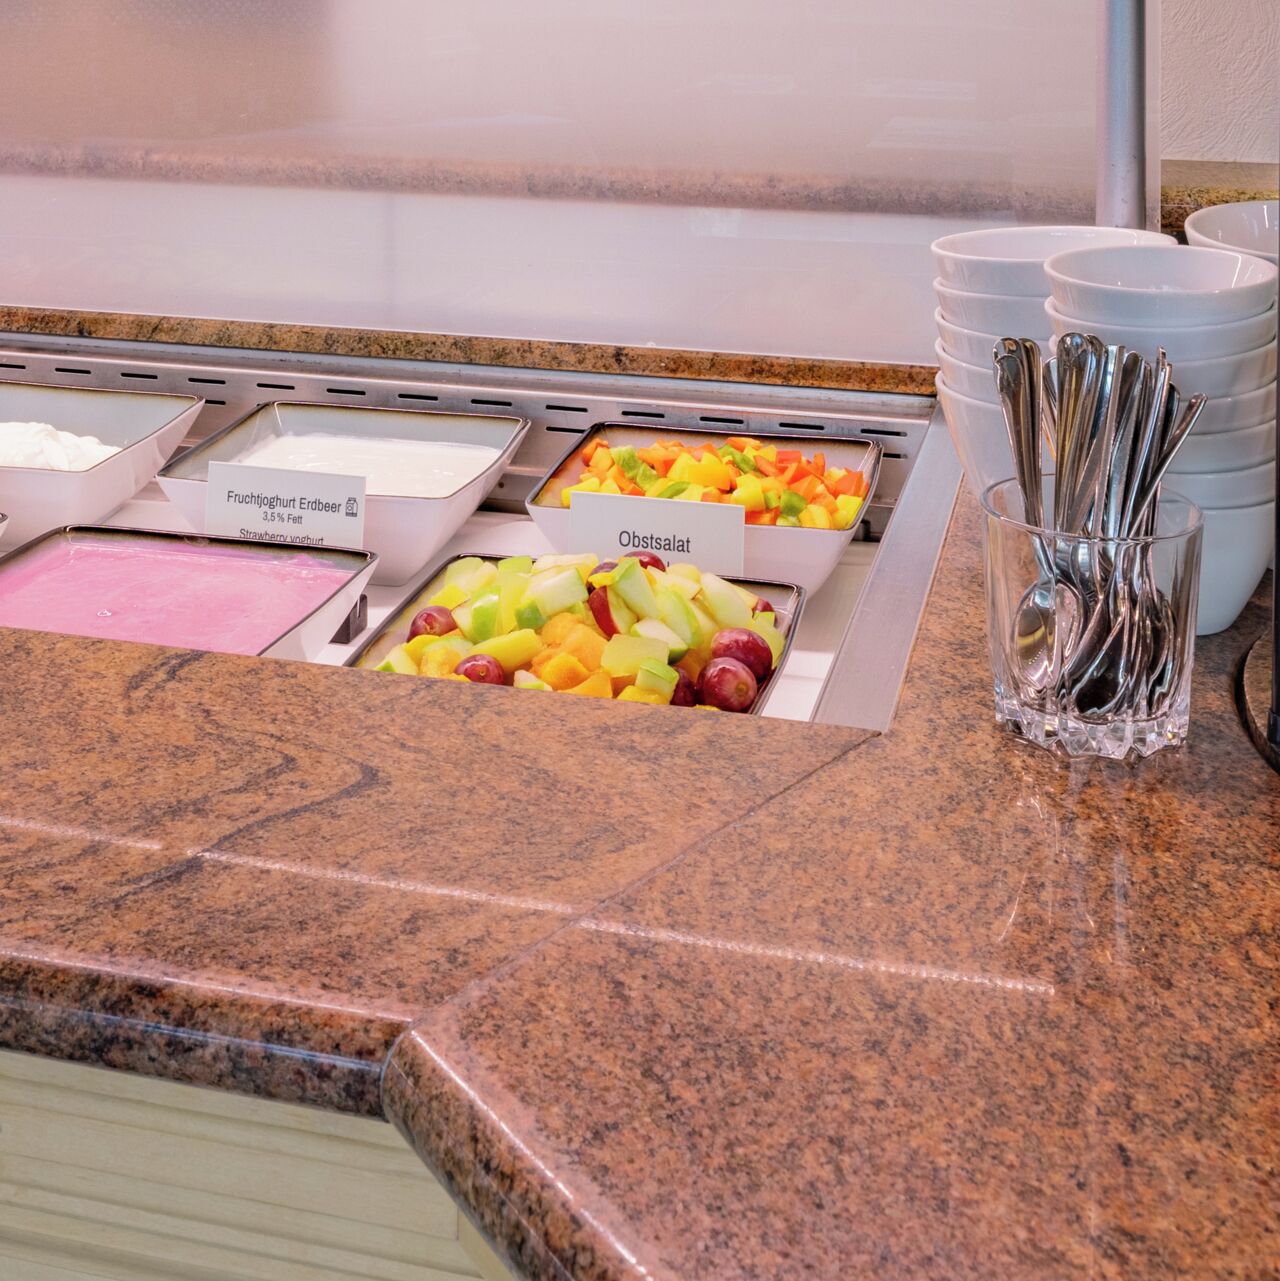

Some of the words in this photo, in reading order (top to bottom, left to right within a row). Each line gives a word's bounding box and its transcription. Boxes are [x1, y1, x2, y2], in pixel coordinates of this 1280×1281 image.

[226, 490, 296, 510] Fruchtjoghurt
[299, 497, 342, 513] Erdbeer
[287, 514, 303, 525] Fett
[619, 530, 691, 553] Obstsalat
